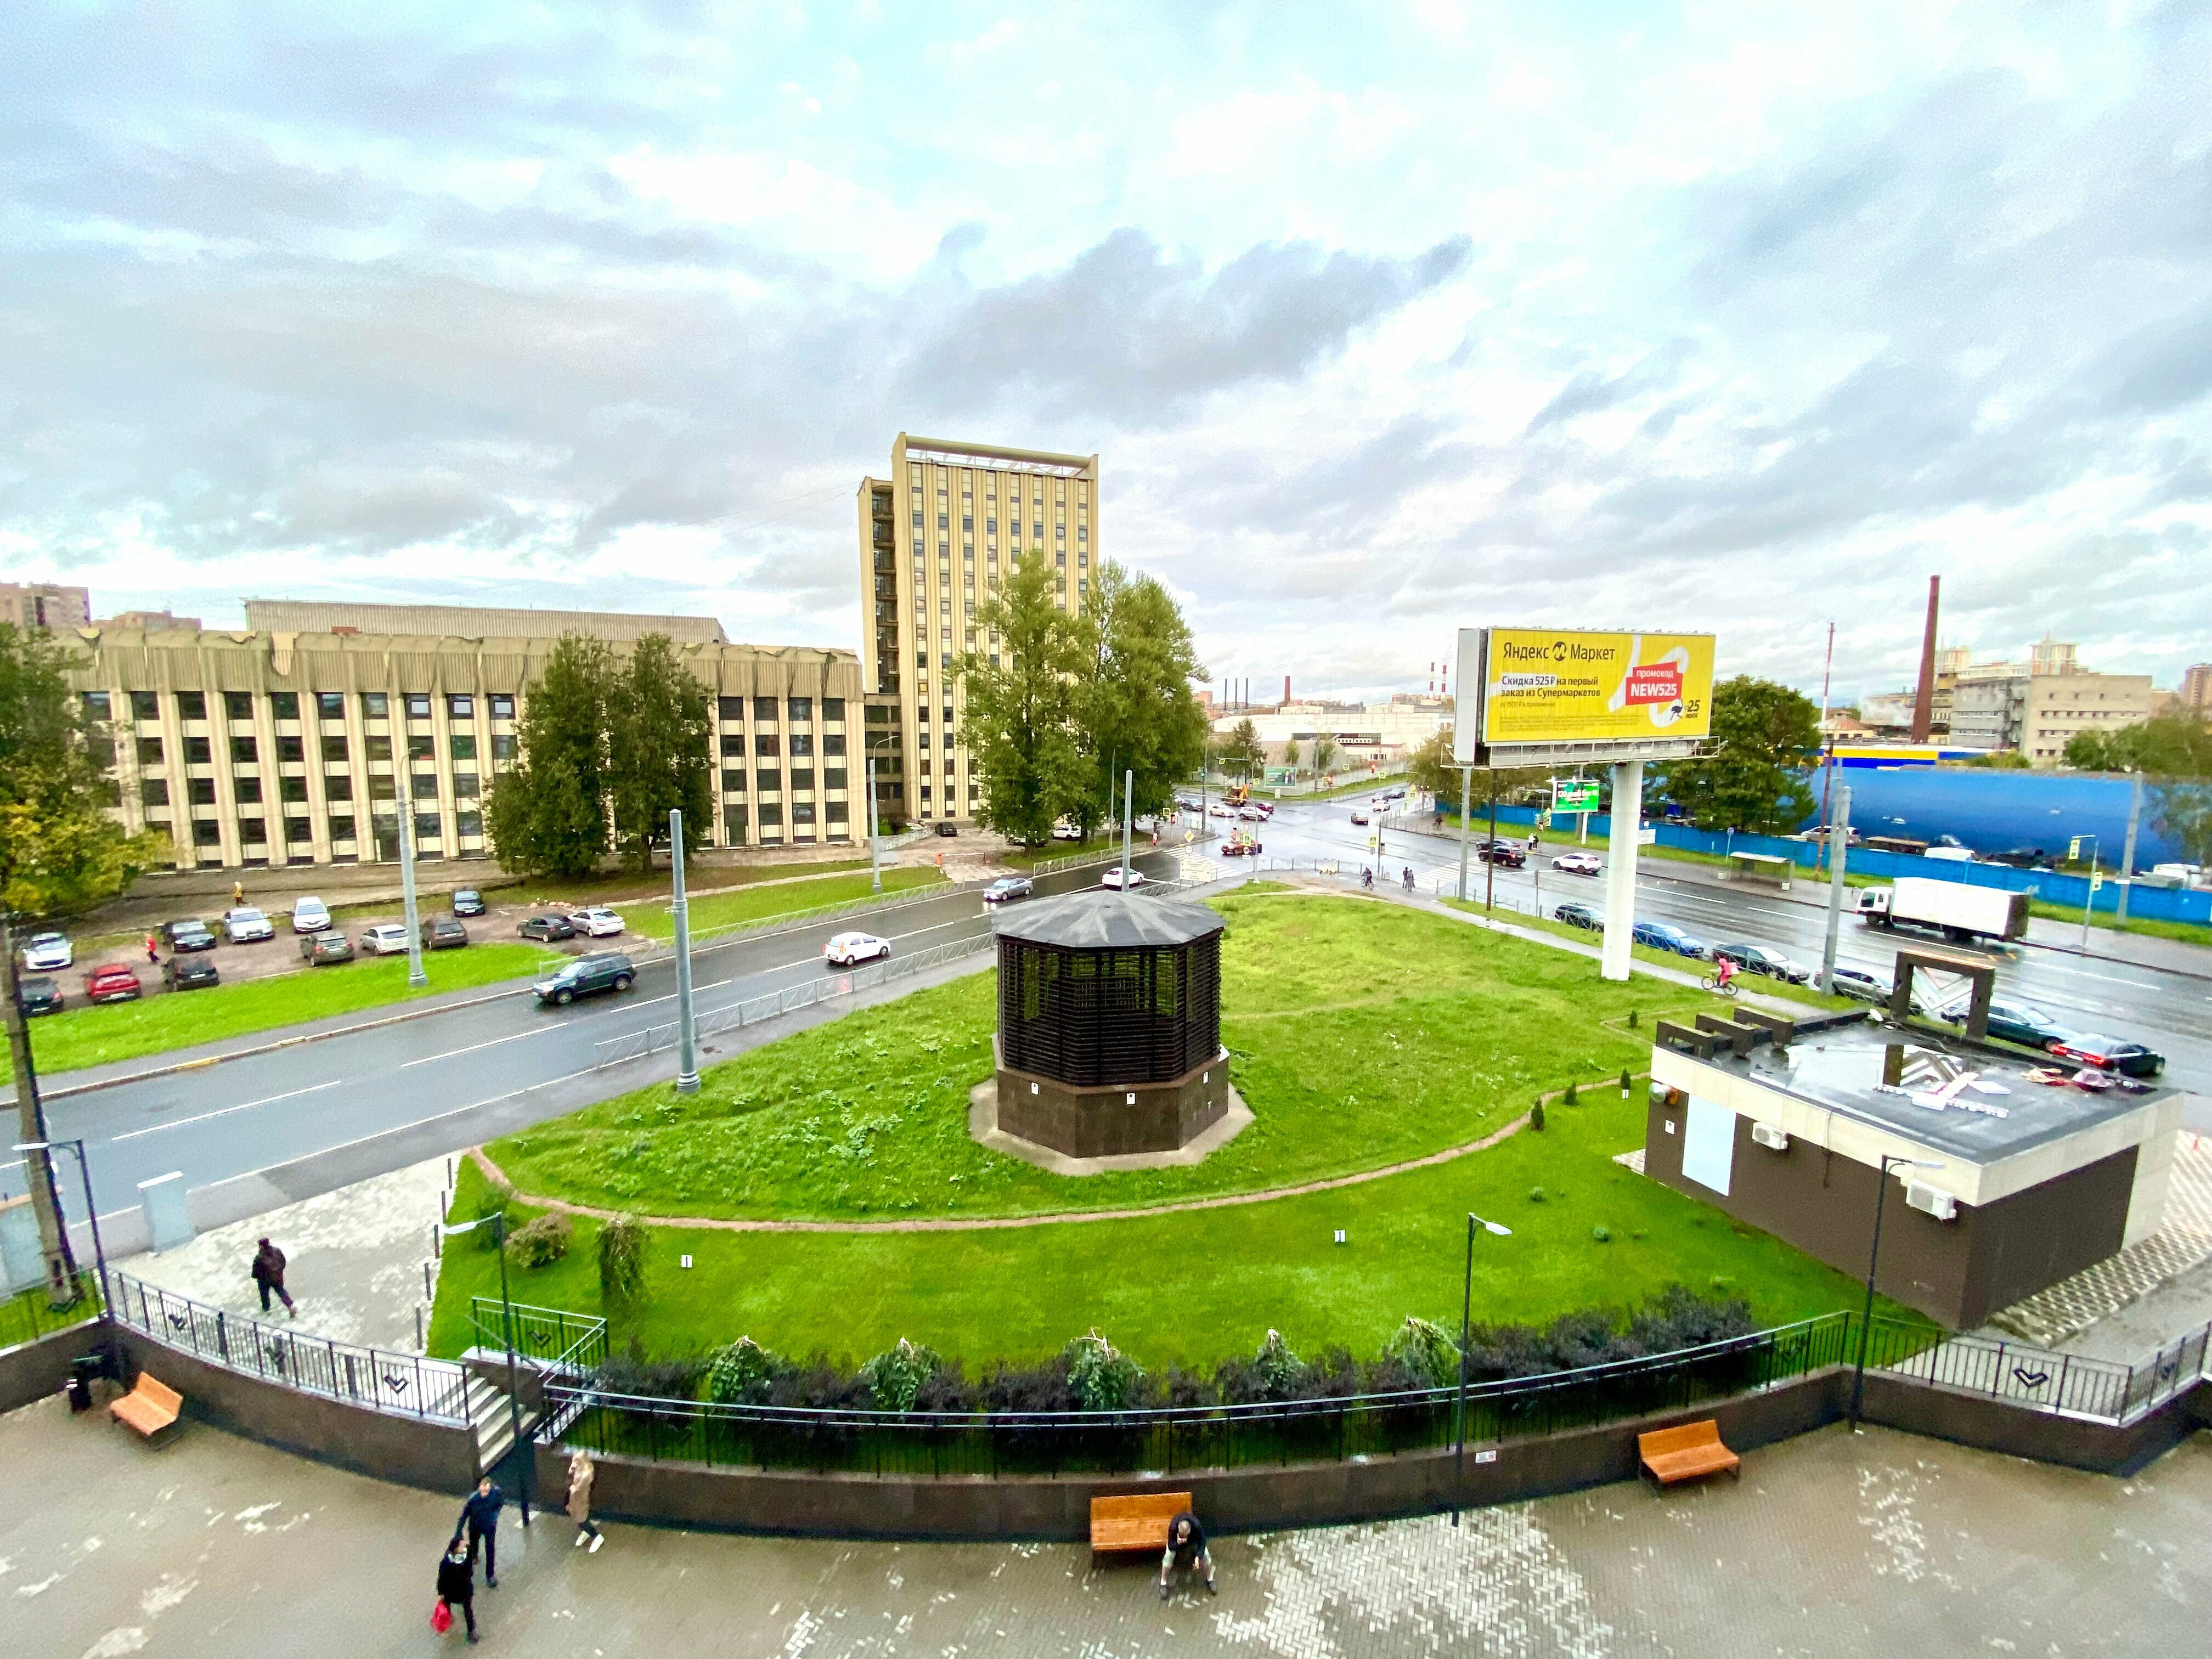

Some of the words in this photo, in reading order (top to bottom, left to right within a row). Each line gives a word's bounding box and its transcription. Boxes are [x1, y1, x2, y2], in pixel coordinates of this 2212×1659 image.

[1503, 641, 1549, 661] Яндекс
[1570, 644, 1616, 663] Маркет
[1636, 669, 1674, 680] промокод
[1502, 675, 1534, 686] Скидка
[1567, 676, 1598, 687] первый
[1537, 688, 1600, 699] Супермаркетов
[1630, 682, 1678, 697] NEW525
